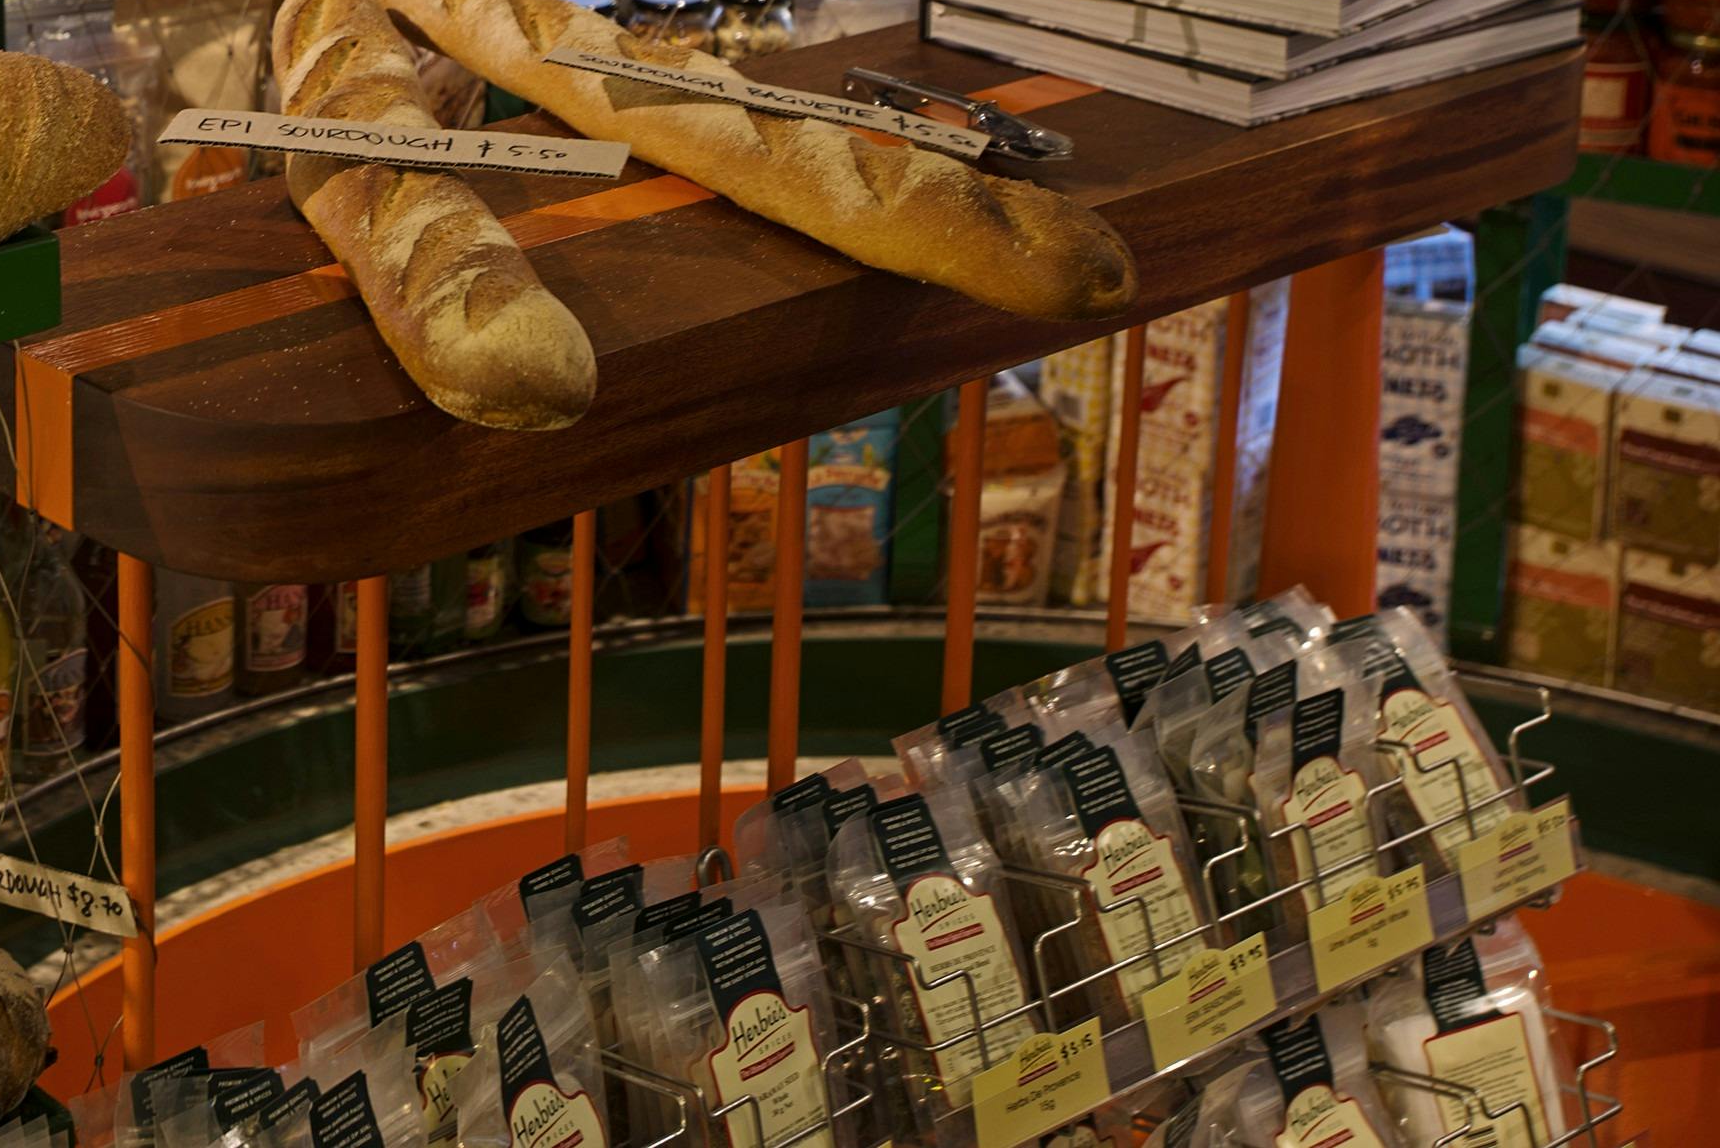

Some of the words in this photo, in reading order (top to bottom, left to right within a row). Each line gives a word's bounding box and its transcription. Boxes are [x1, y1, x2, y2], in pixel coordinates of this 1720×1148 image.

[577, 51, 726, 95] SOURDOUGH
[744, 85, 877, 121] BAGUETTE
[197, 116, 254, 135] EPI
[277, 122, 455, 154] SOURDOUGH
[66, 883, 124, 918] $8.70
[731, 999, 793, 1056] Herbie's
[512, 1088, 569, 1148] Herbie's
